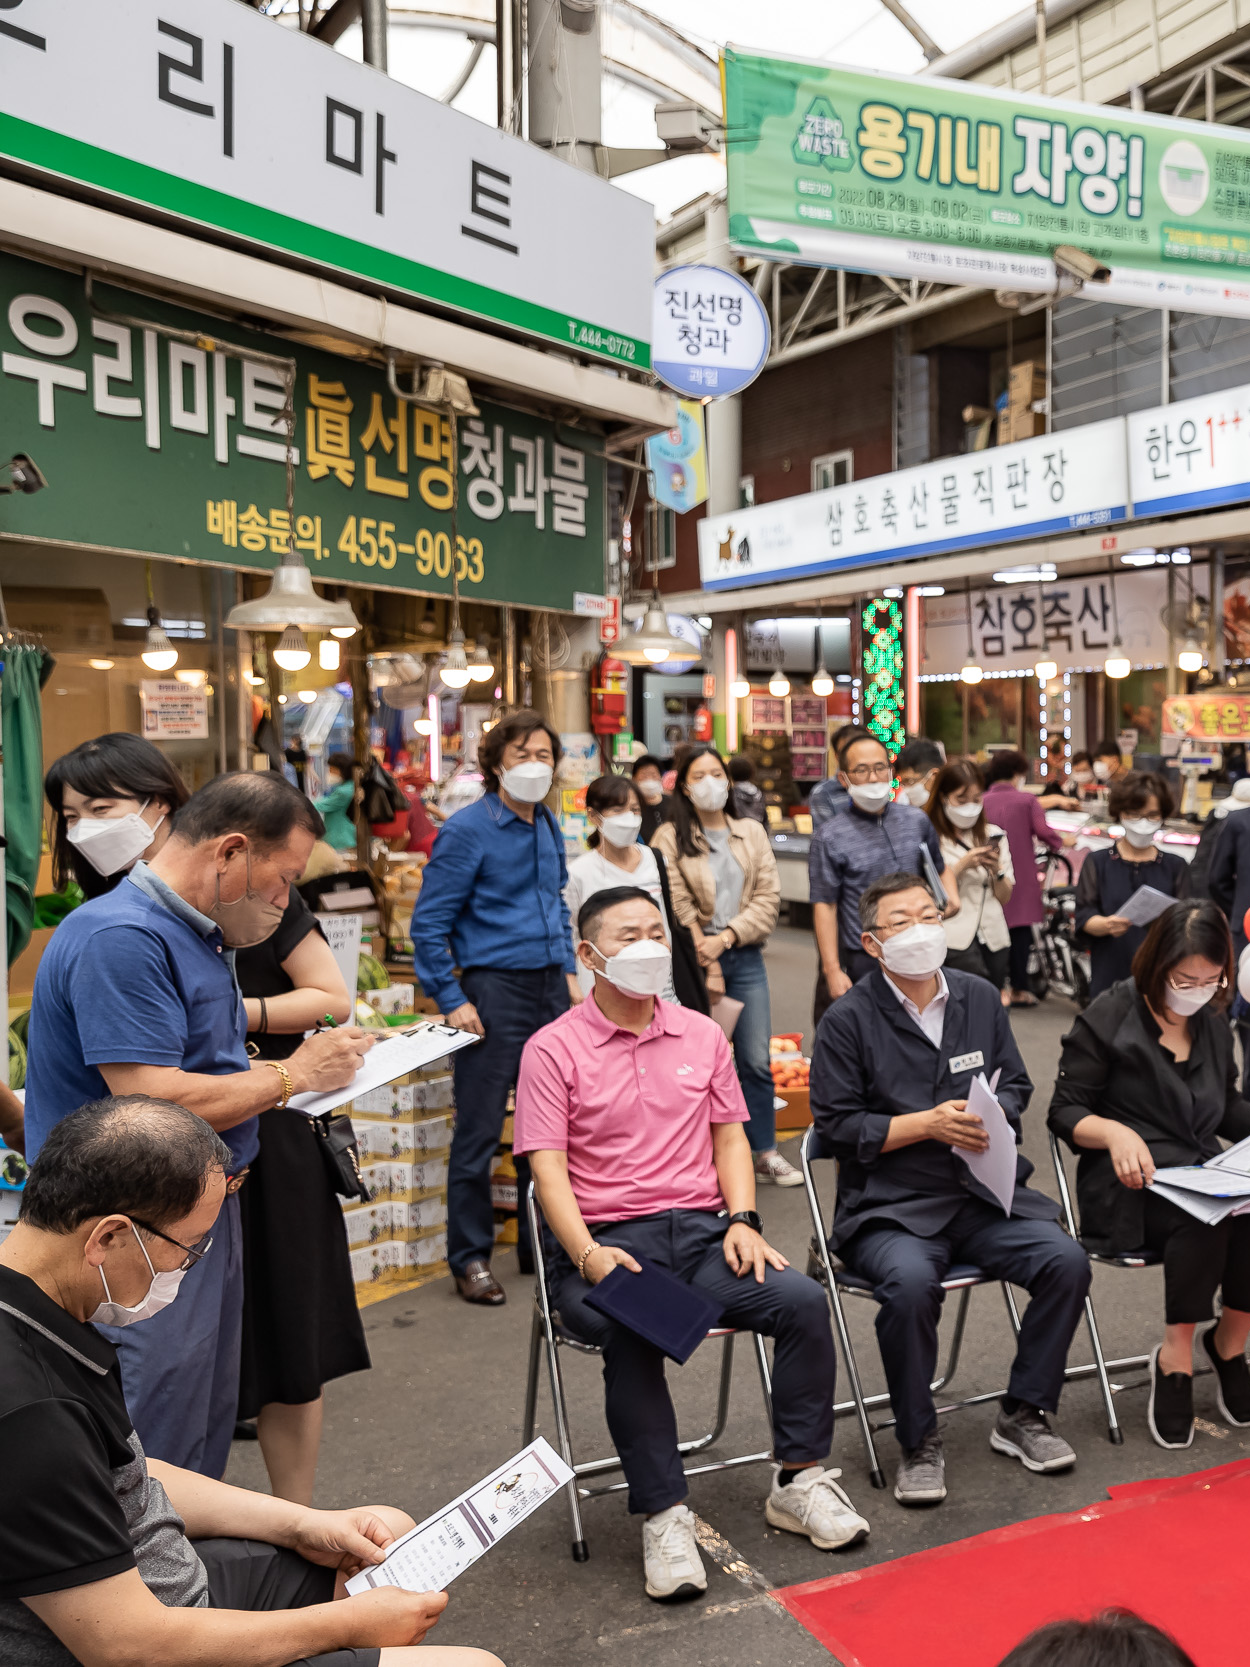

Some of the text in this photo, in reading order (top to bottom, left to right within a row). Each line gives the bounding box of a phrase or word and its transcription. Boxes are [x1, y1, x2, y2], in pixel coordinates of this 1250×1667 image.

[0, 0, 518, 256] 리마트
[798, 133, 850, 158] WASTE
[805, 114, 842, 137] ZERO
[858, 102, 1145, 217] 용기내 자양!
[664, 288, 743, 325] 진선명
[677, 327, 731, 356] 청과
[2, 293, 300, 465] 우리마트
[825, 448, 1068, 547] 삼호축산물직판장
[338, 516, 485, 583] 455-9063
